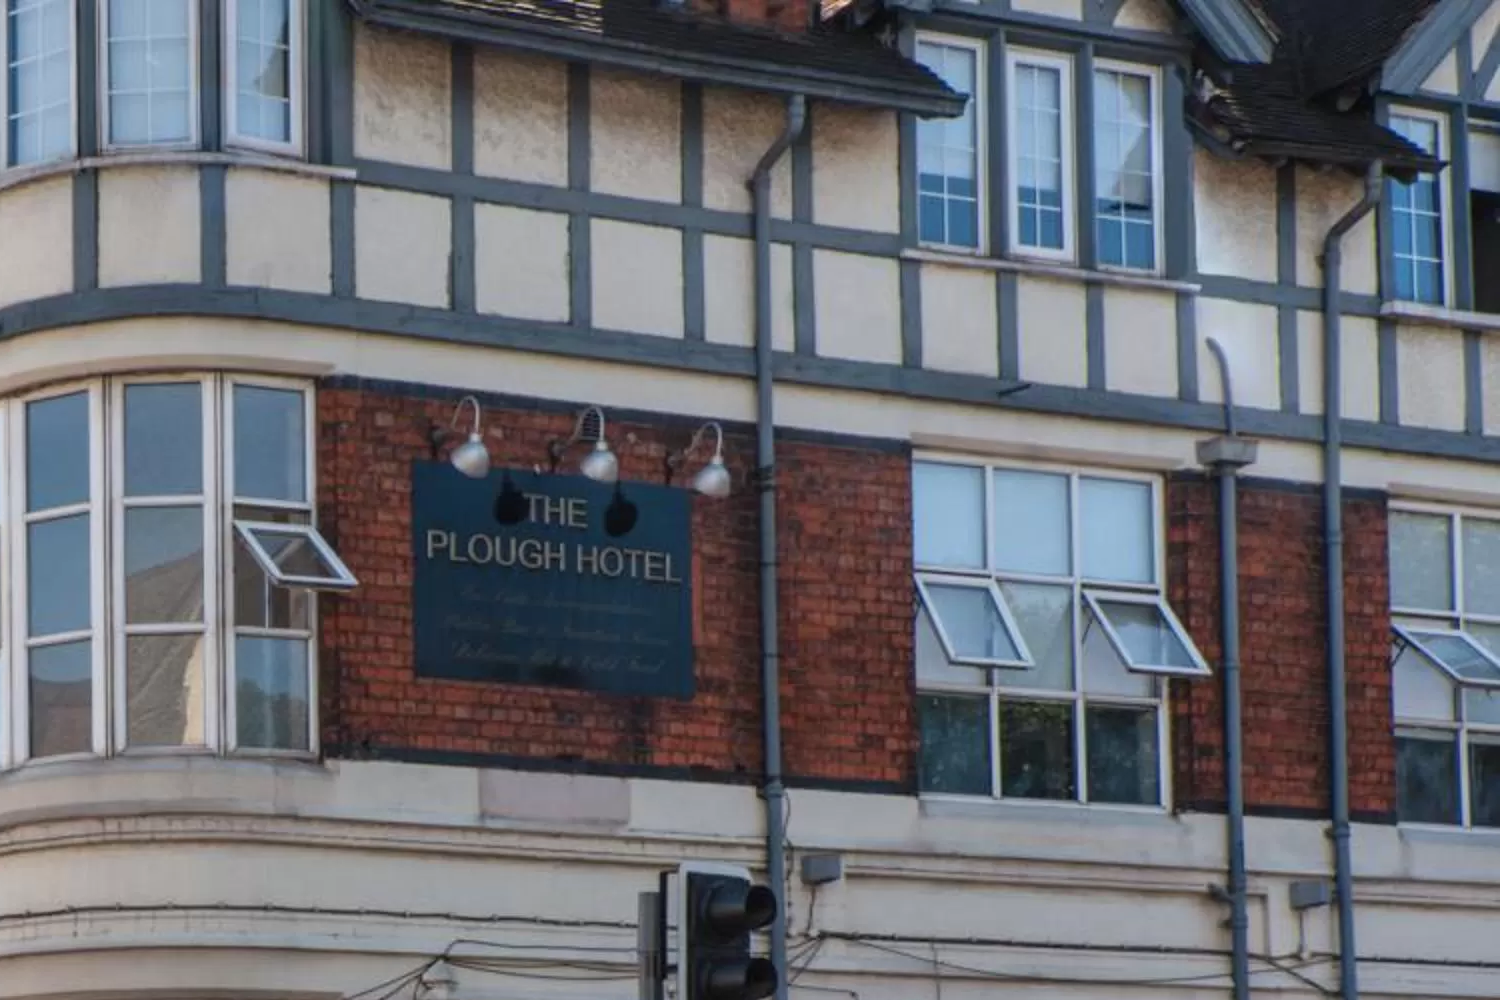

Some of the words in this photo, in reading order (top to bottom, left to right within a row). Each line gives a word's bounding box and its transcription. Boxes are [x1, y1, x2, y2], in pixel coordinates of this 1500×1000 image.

[522, 492, 589, 529] THE
[426, 529, 566, 573] PLOUGH
[576, 543, 682, 583] HOTEL
